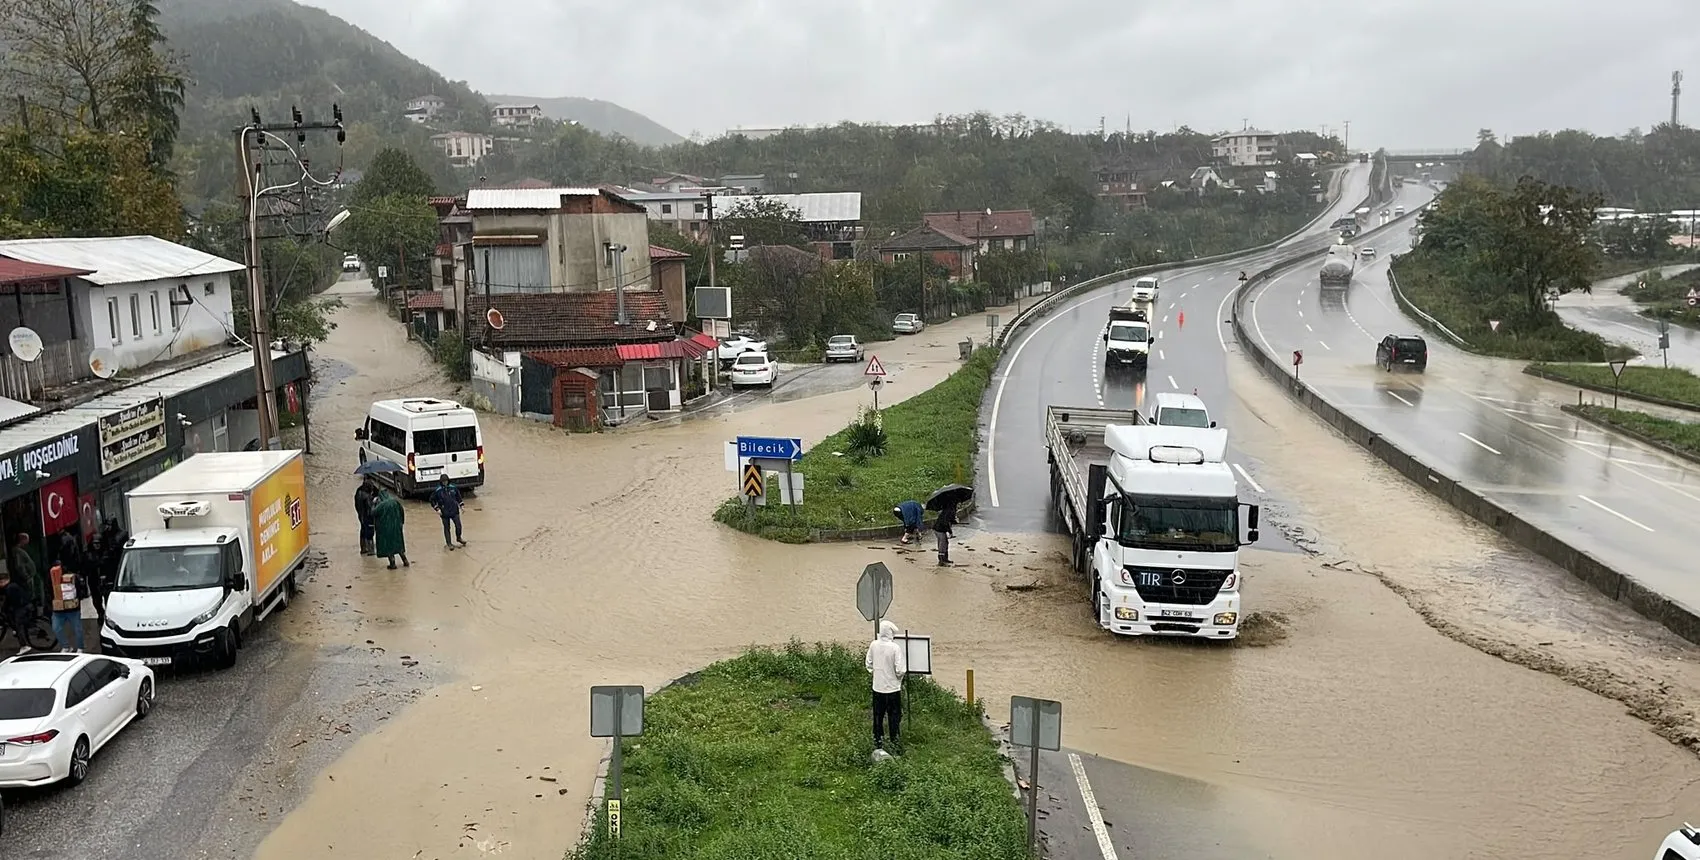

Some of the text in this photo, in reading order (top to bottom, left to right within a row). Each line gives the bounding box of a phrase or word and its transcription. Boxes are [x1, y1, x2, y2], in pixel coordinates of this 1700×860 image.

[23, 434, 79, 469] HOŞGELDİNİZ
[740, 442, 785, 453] Bilecik
[1140, 572, 1161, 586] TIR
